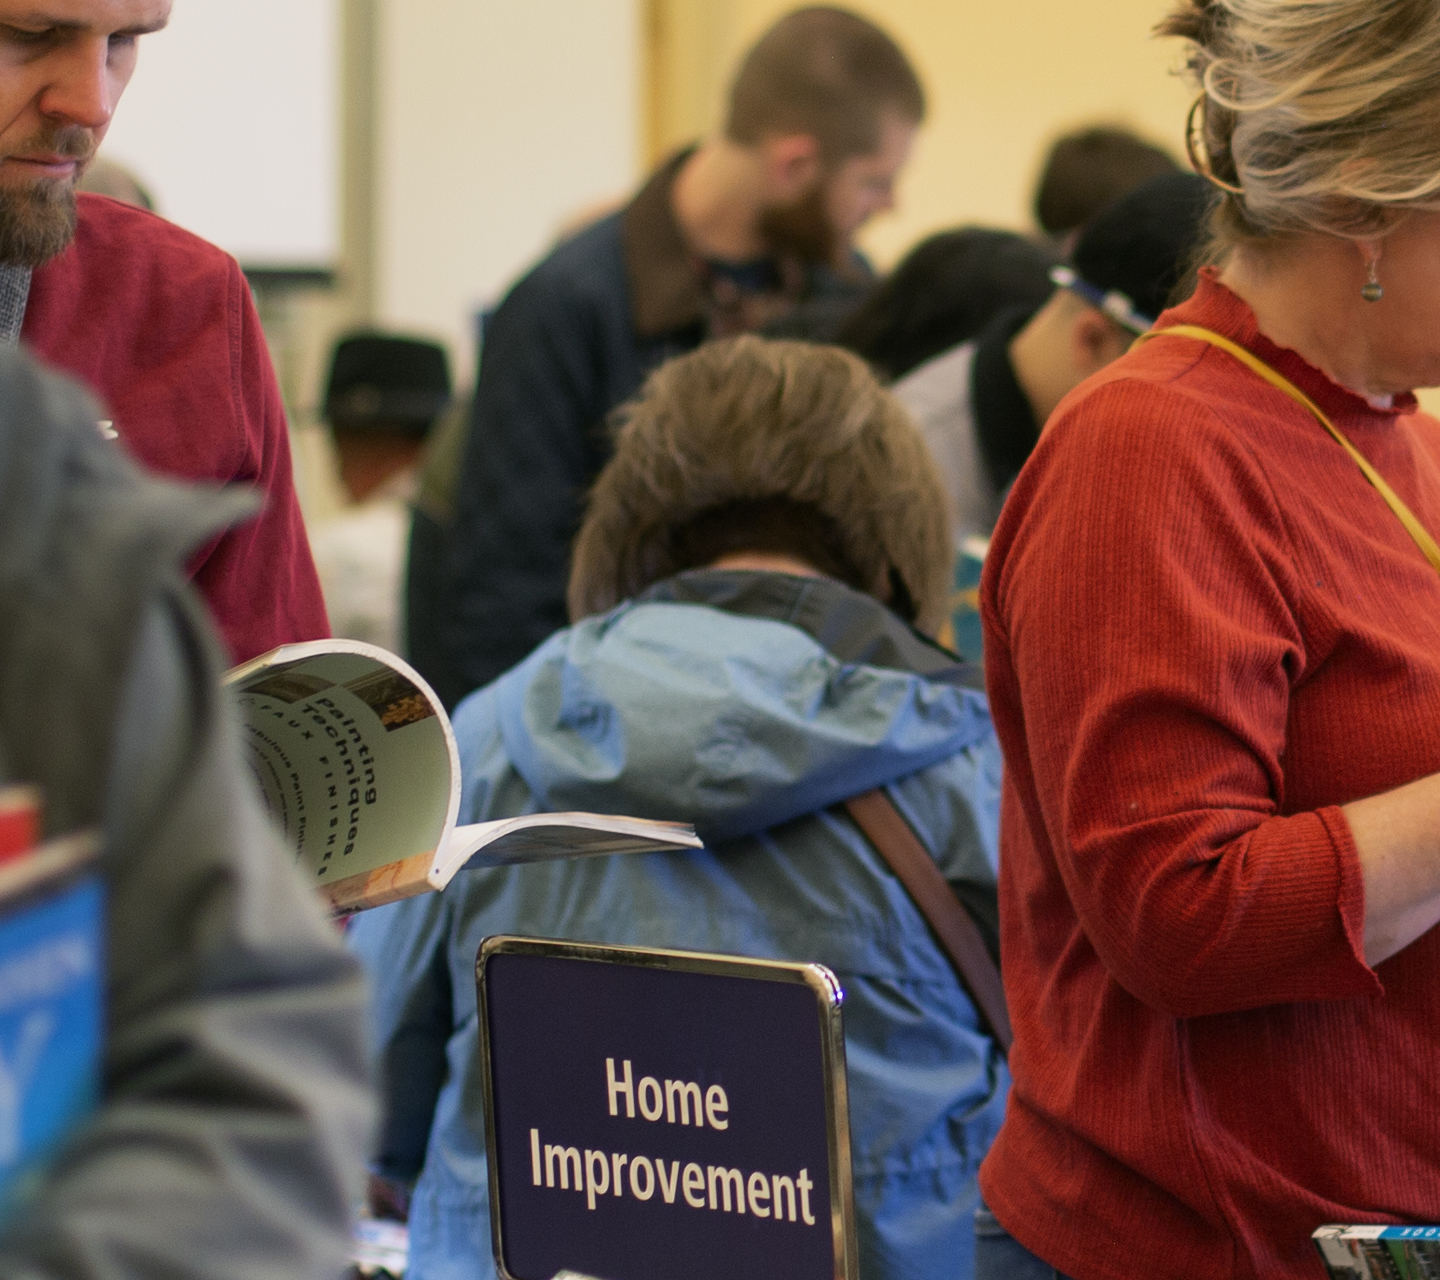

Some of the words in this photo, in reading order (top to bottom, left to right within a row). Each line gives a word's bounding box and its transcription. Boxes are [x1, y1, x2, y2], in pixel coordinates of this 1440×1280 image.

[302, 704, 360, 856] Techniques
[605, 1057, 729, 1131] Home
[530, 1128, 815, 1226] Improvement
